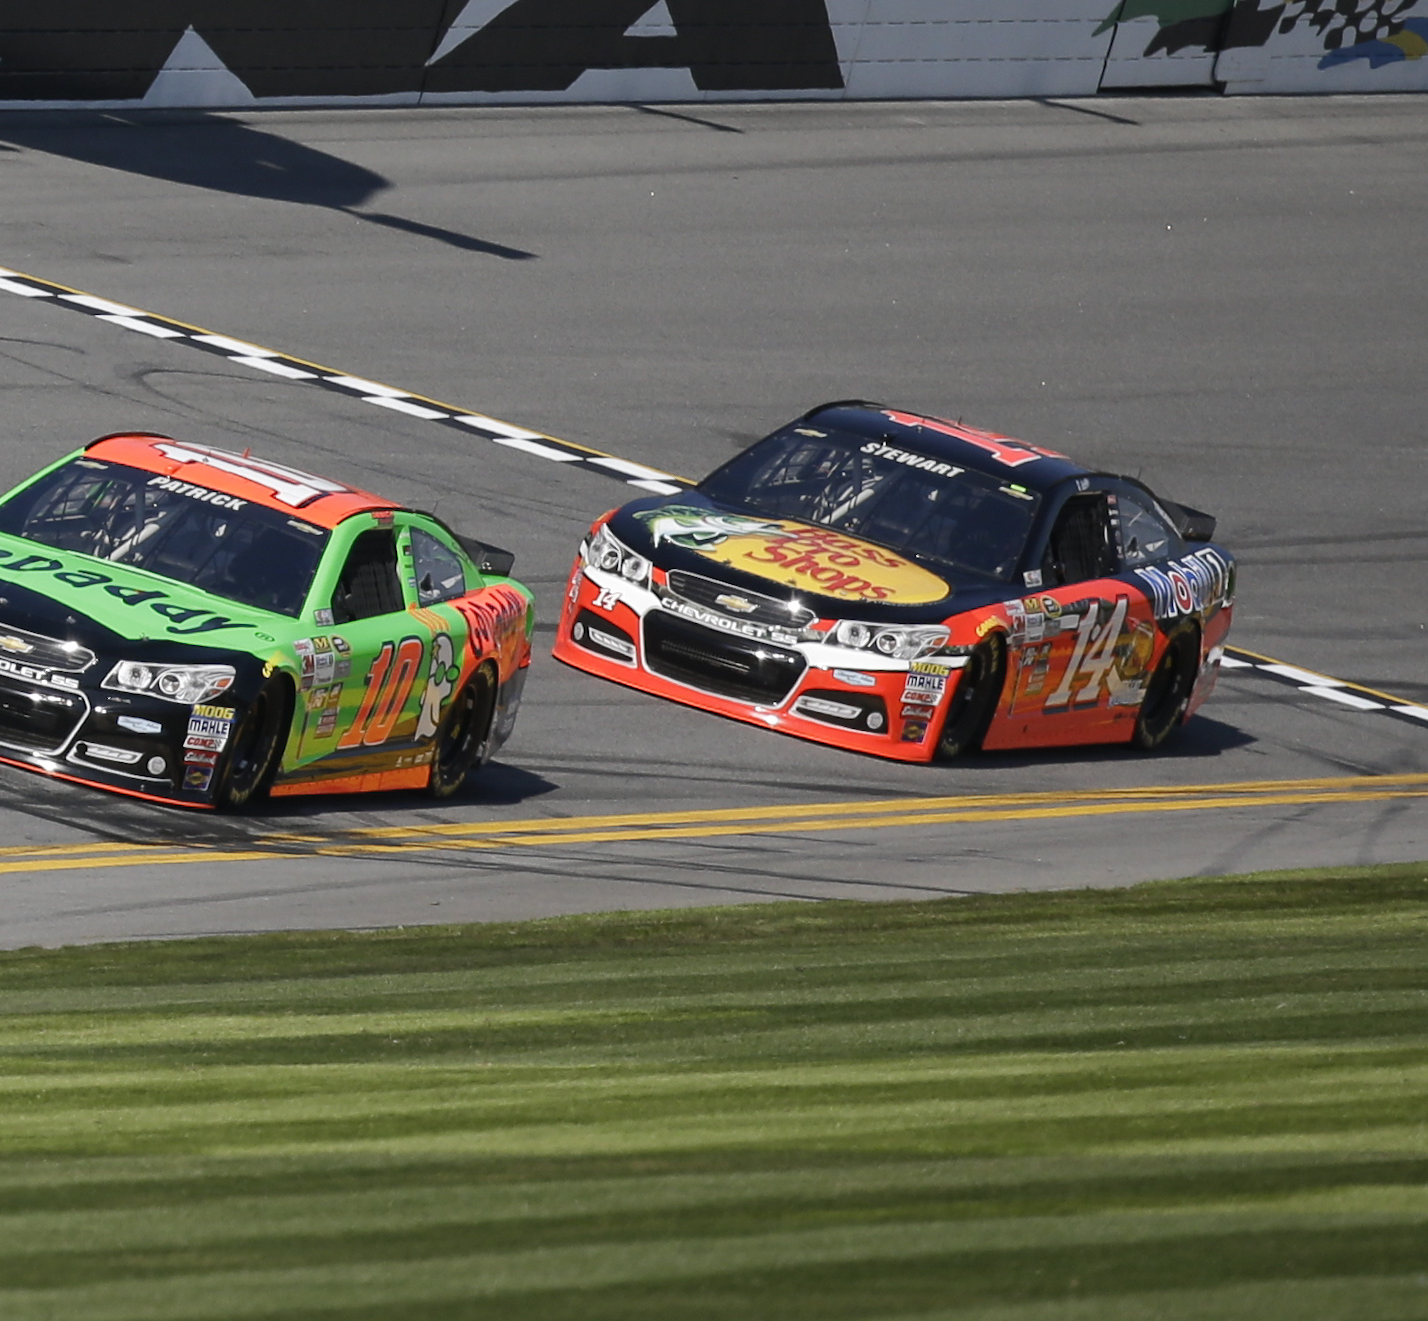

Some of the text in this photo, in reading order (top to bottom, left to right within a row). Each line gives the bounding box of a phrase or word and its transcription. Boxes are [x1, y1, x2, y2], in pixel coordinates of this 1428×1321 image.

[860, 442, 966, 478] STEWART
[148, 474, 247, 511] PATRICK
[766, 537, 861, 568] Pro
[793, 528, 906, 568] Bass
[744, 546, 896, 600] Shops
[1134, 555, 1209, 619] Mobil
[592, 587, 624, 611] 14
[661, 597, 798, 645] CHEVROLET SS
[911, 662, 949, 677] MOOG
[1045, 597, 1128, 707] 14
[50, 675, 79, 689] SS
[337, 635, 424, 749] 10
[907, 675, 945, 692] MAHLE
[188, 718, 230, 736] MAHLE
[192, 705, 235, 720] MOOG
